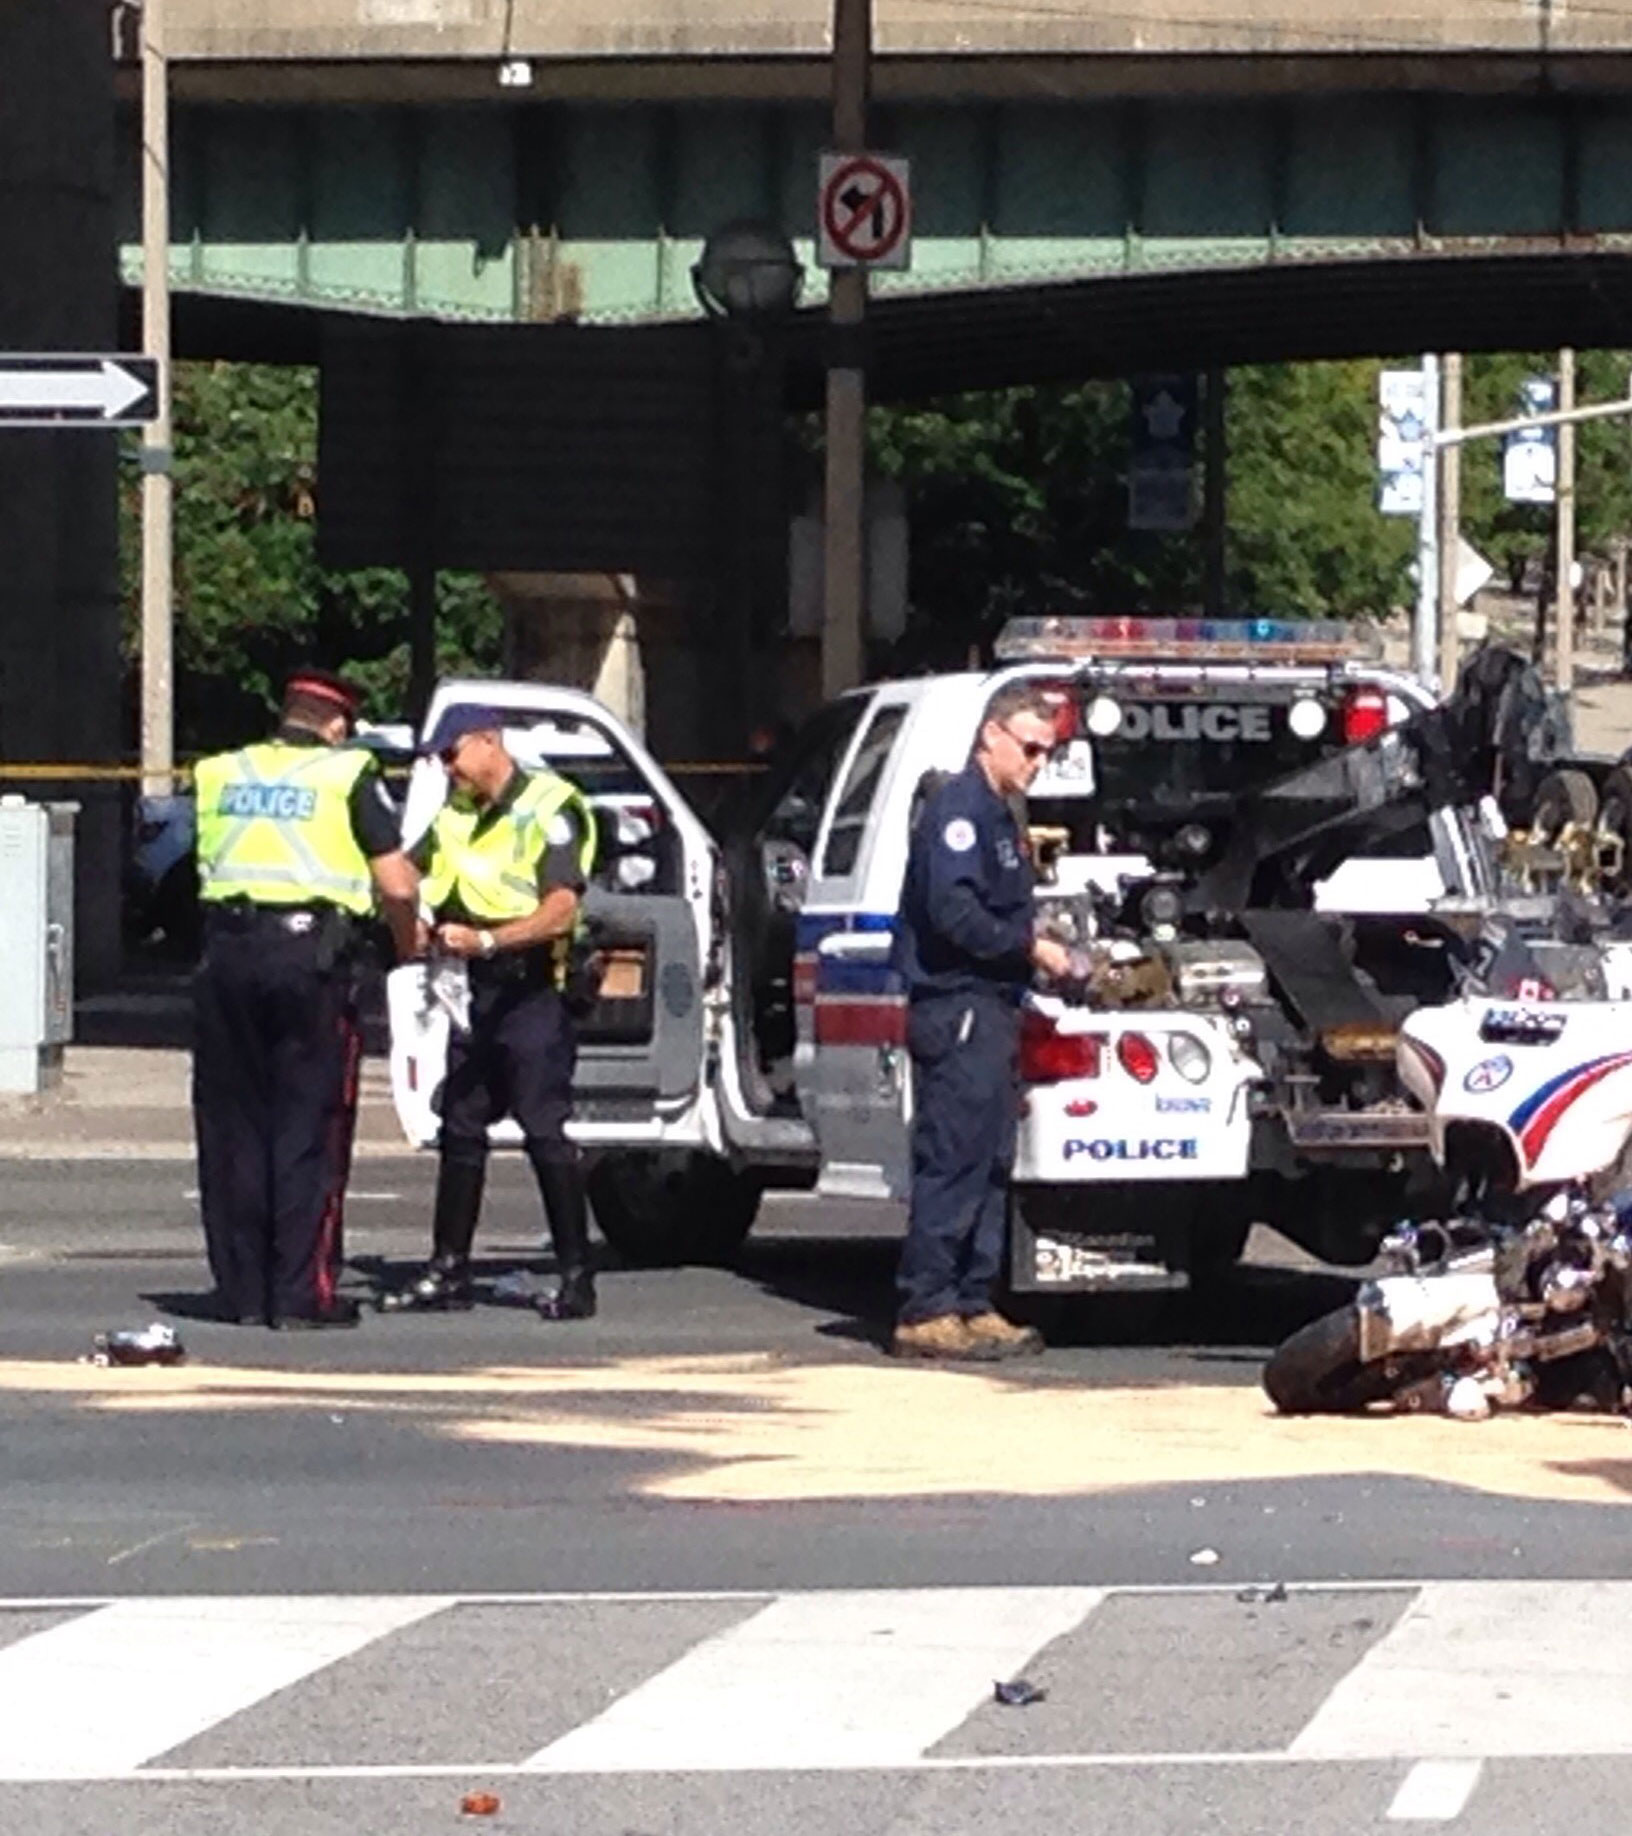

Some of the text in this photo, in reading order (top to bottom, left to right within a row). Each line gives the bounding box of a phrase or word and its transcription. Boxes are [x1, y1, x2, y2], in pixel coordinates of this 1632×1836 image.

[1120, 706, 1272, 742] OLICE
[222, 786, 314, 816] POLICE
[1063, 1138, 1199, 1161] POLICE
